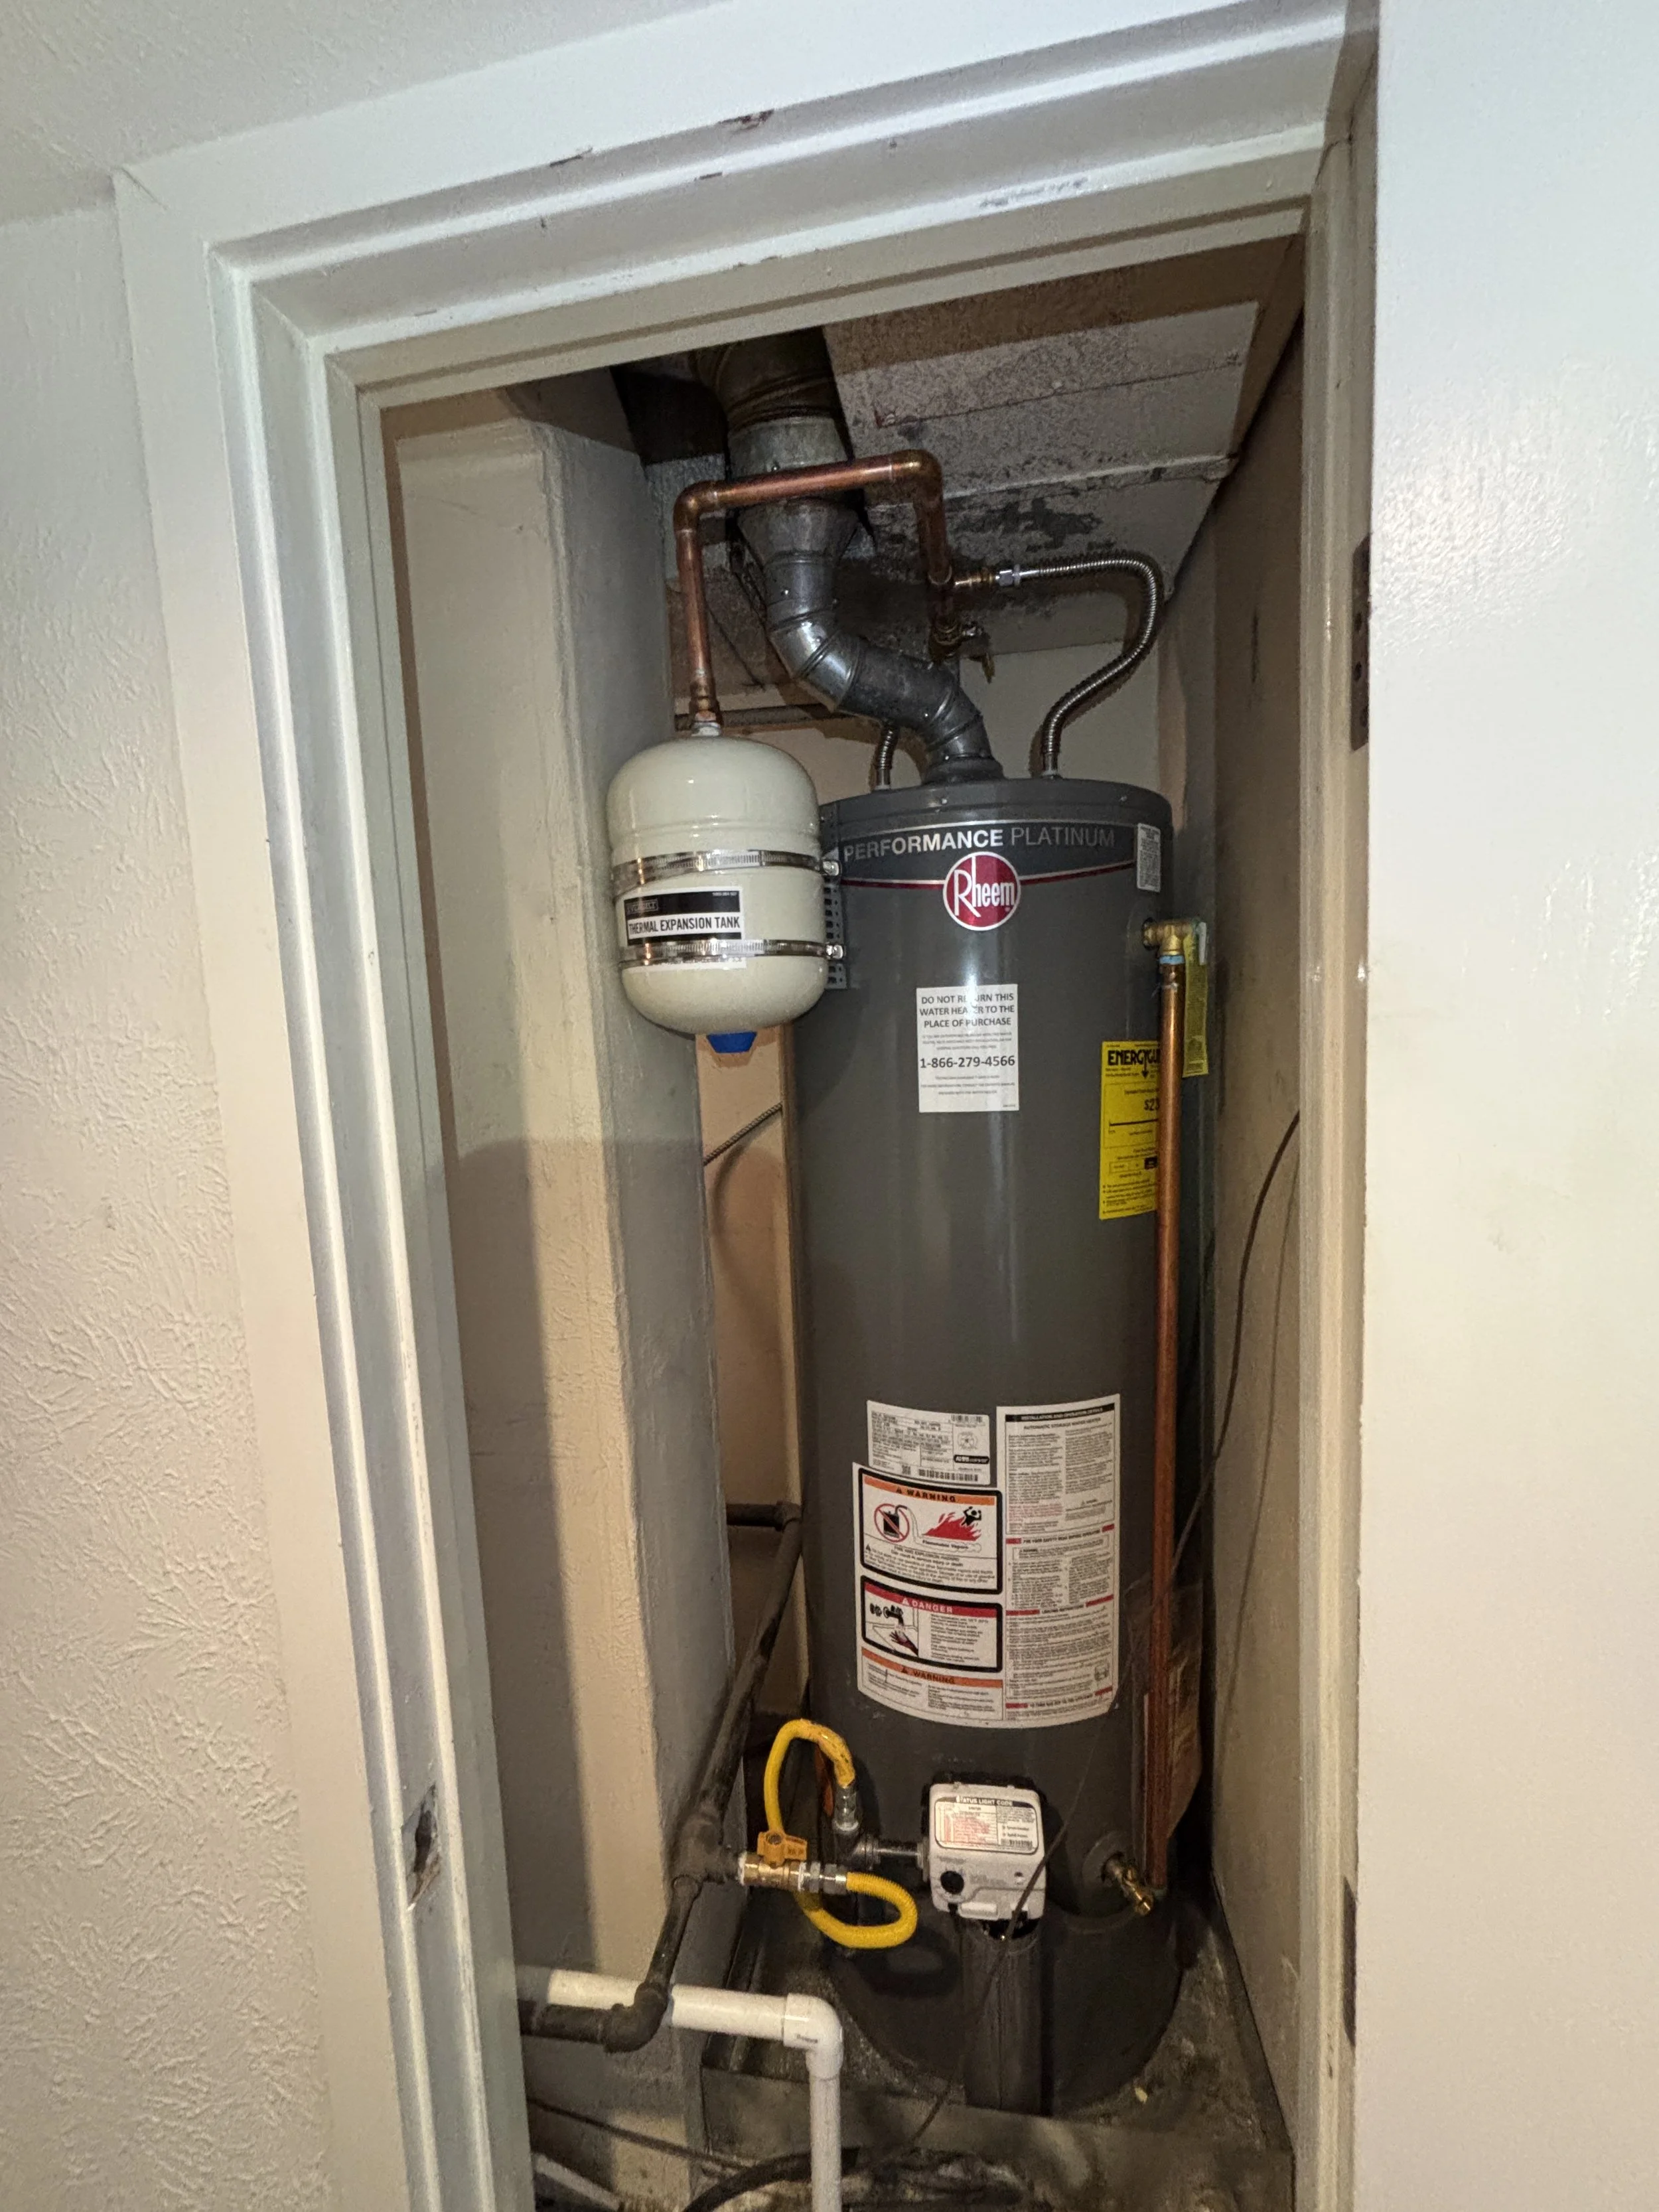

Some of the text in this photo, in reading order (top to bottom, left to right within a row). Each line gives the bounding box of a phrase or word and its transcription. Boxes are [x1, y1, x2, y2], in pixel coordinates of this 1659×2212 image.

[843, 827, 1116, 862] PERFORMANCE PLATINUM
[954, 855, 1015, 917] Rheem
[628, 917, 741, 935] THERMAL EXPANSION TANK
[958, 994, 992, 1003] REURN
[919, 1007, 949, 1016] WATER
[952, 1006, 983, 1015] HEAER
[999, 1005, 1015, 1013] THE
[924, 1019, 949, 1028] PLACE
[966, 1017, 1011, 1027] PURCHASE
[920, 1055, 1015, 1069] 1-866-279-4566
[906, 1488, 956, 1503] WARNING
[912, 1599, 953, 1613] DANGER
[913, 1670, 956, 1684] WARNING
